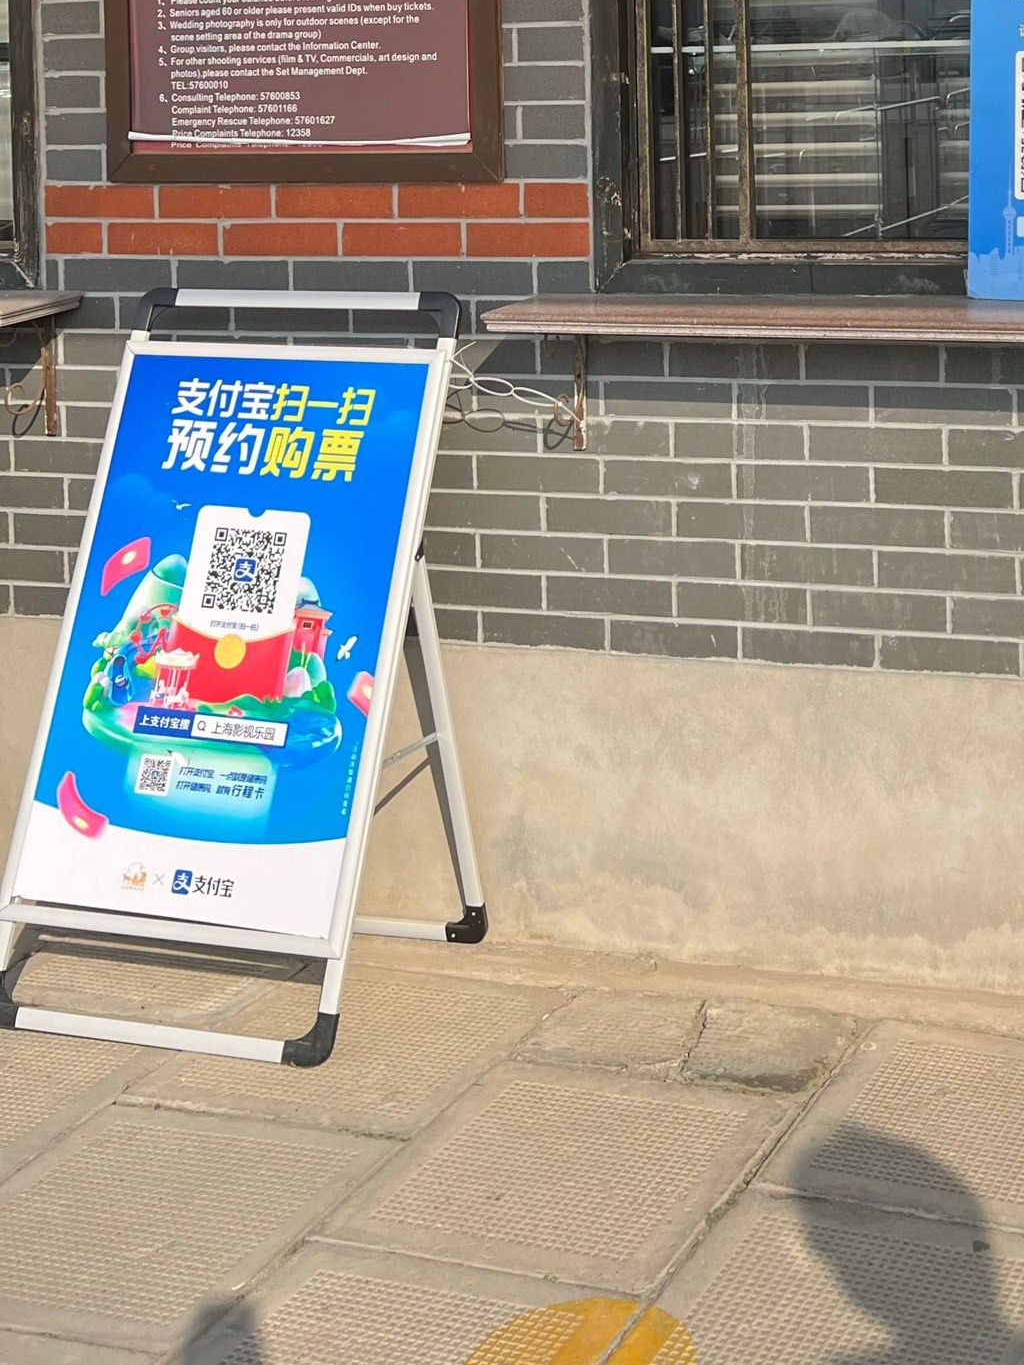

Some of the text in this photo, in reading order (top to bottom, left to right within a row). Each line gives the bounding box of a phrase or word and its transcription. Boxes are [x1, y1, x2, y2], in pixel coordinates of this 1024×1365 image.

[172, 104, 297, 115] Complaint Telephone: 57601166
[172, 116, 335, 127] Emergency Rescue Telephone: 57601627
[171, 378, 376, 427] 支付宝扫一扫
[161, 419, 364, 482] 预约购票
[139, 714, 191, 732] 上支付宝搜
[211, 721, 276, 741] 上海影视乐园
[192, 877, 235, 898] 支付宝
